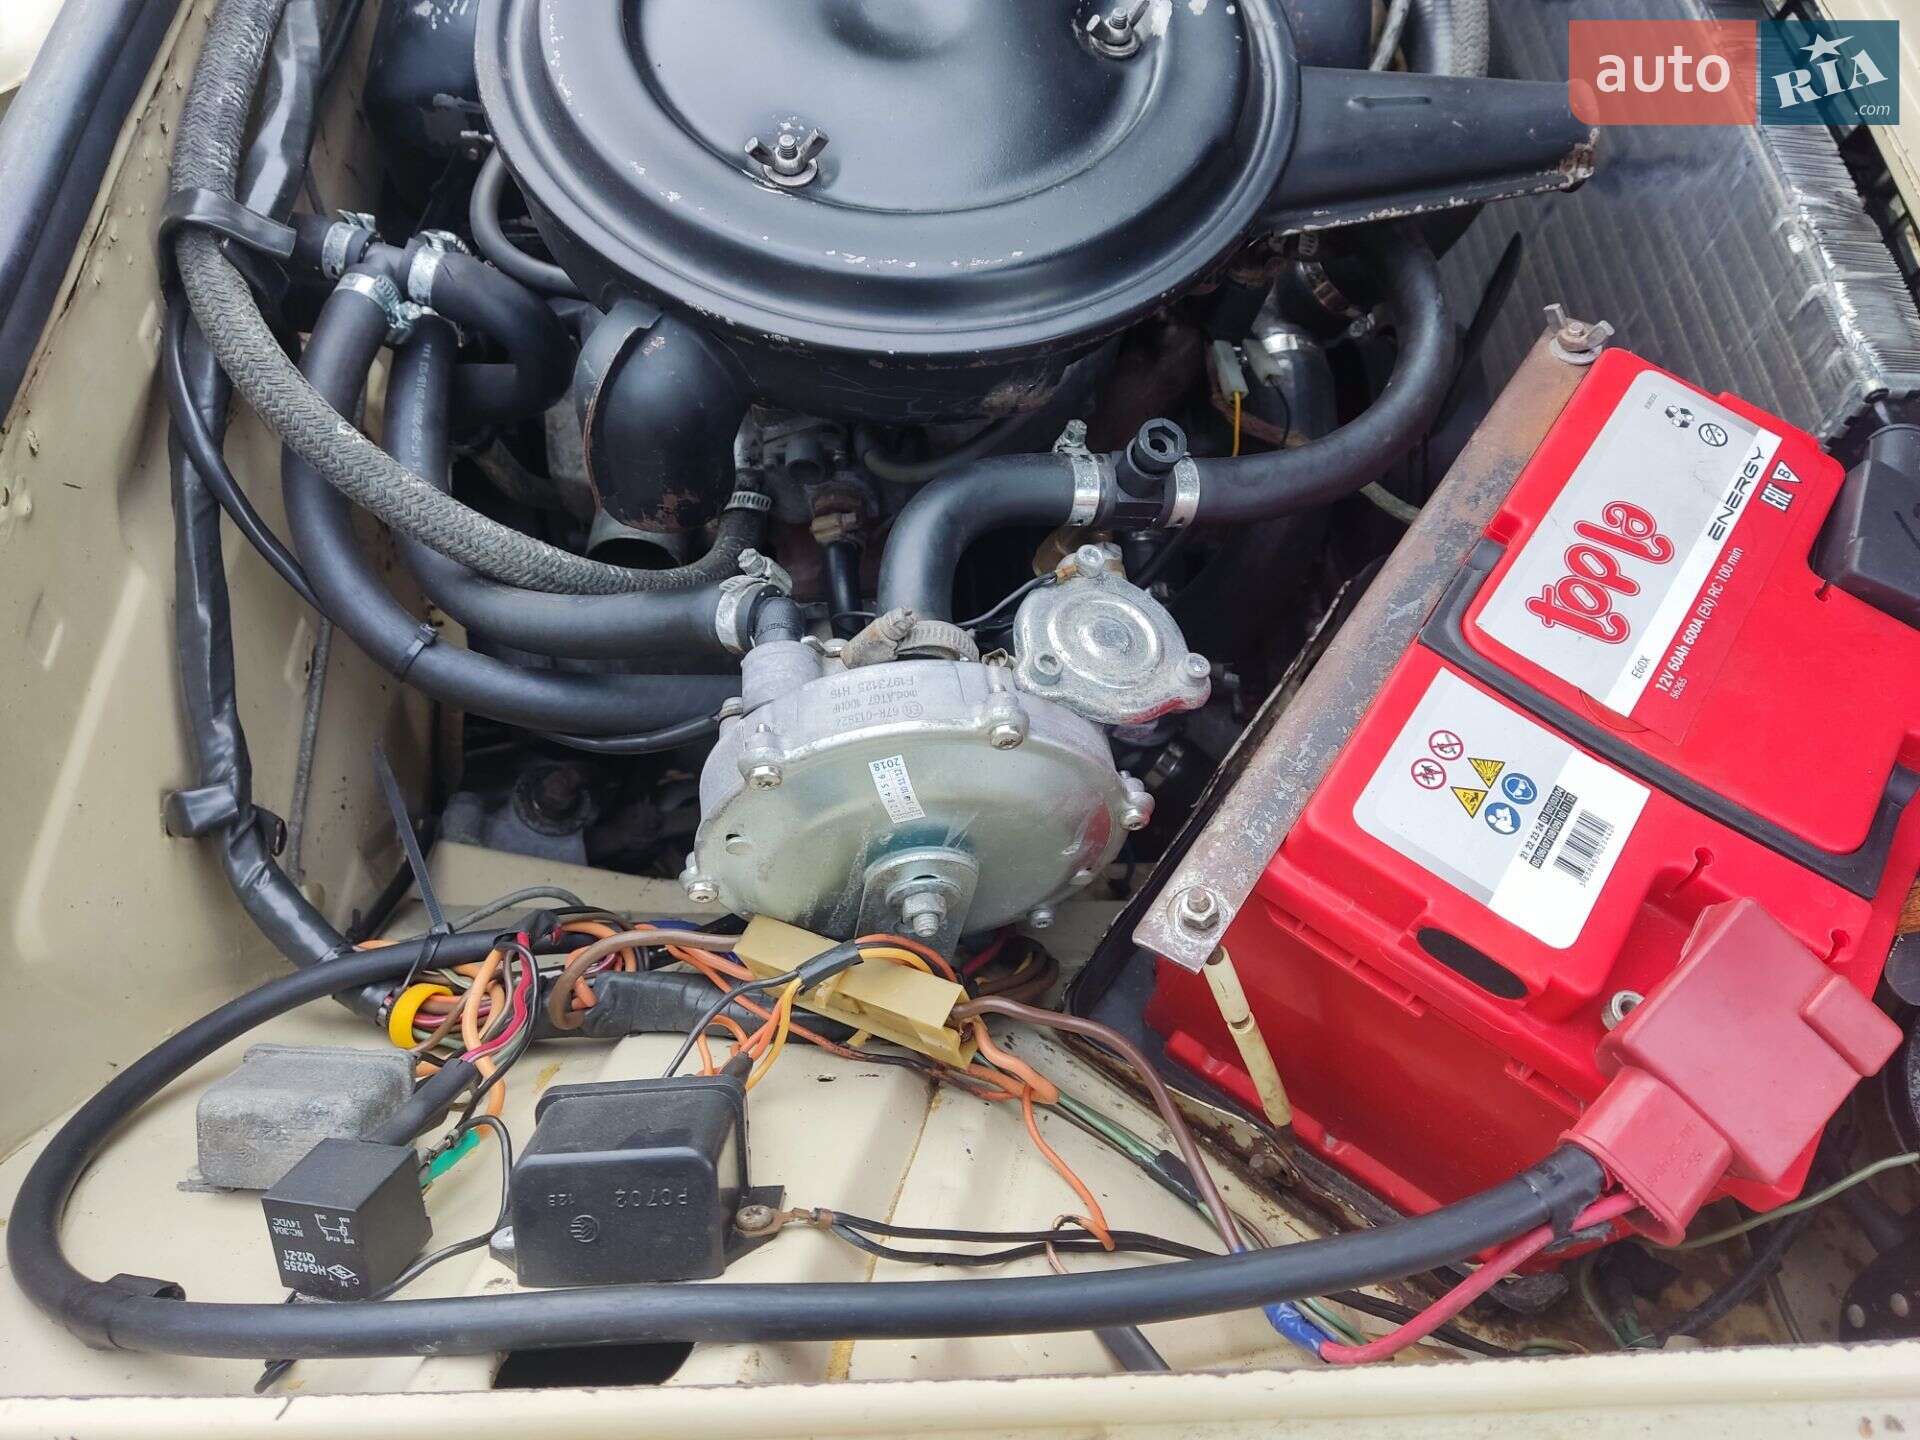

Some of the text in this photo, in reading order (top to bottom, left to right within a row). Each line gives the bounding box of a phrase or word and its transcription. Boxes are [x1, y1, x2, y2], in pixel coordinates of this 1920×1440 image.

[1777, 468, 1791, 480] B
[1708, 446, 1764, 541] ENERGY
[1526, 500, 1675, 644] topla
[1656, 547, 1744, 692] 12V 60Ah 600A (EN) RC 100 min
[1632, 655, 1652, 679] E60X
[873, 757, 901, 771] 2018
[272, 1217, 301, 1229] 14VDC
[283, 1260, 327, 1276] HG4255
